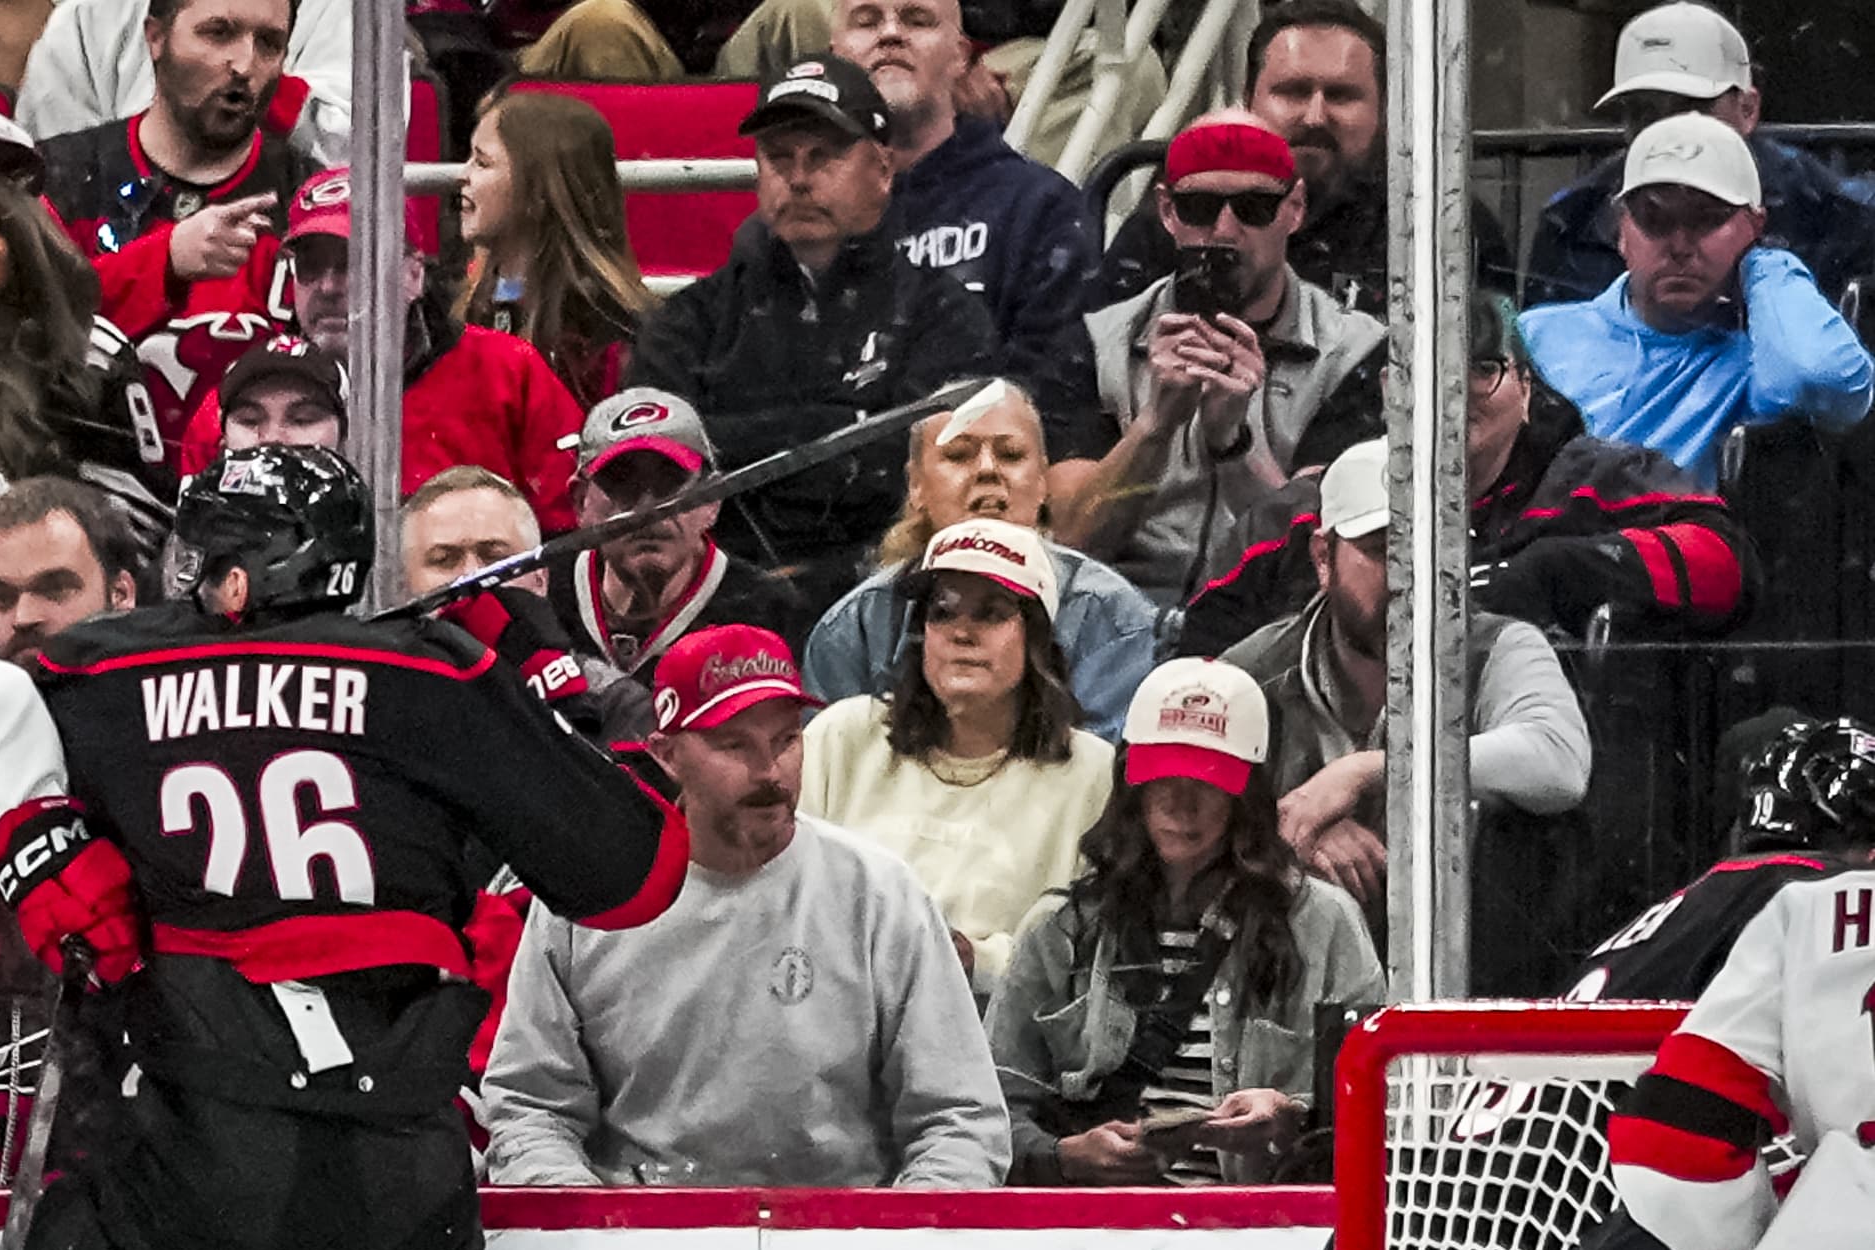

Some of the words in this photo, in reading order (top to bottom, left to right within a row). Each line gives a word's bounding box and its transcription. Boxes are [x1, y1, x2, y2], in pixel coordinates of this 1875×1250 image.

[326, 561, 358, 597] 26
[141, 663, 369, 742] WALKER
[158, 748, 376, 907] 26
